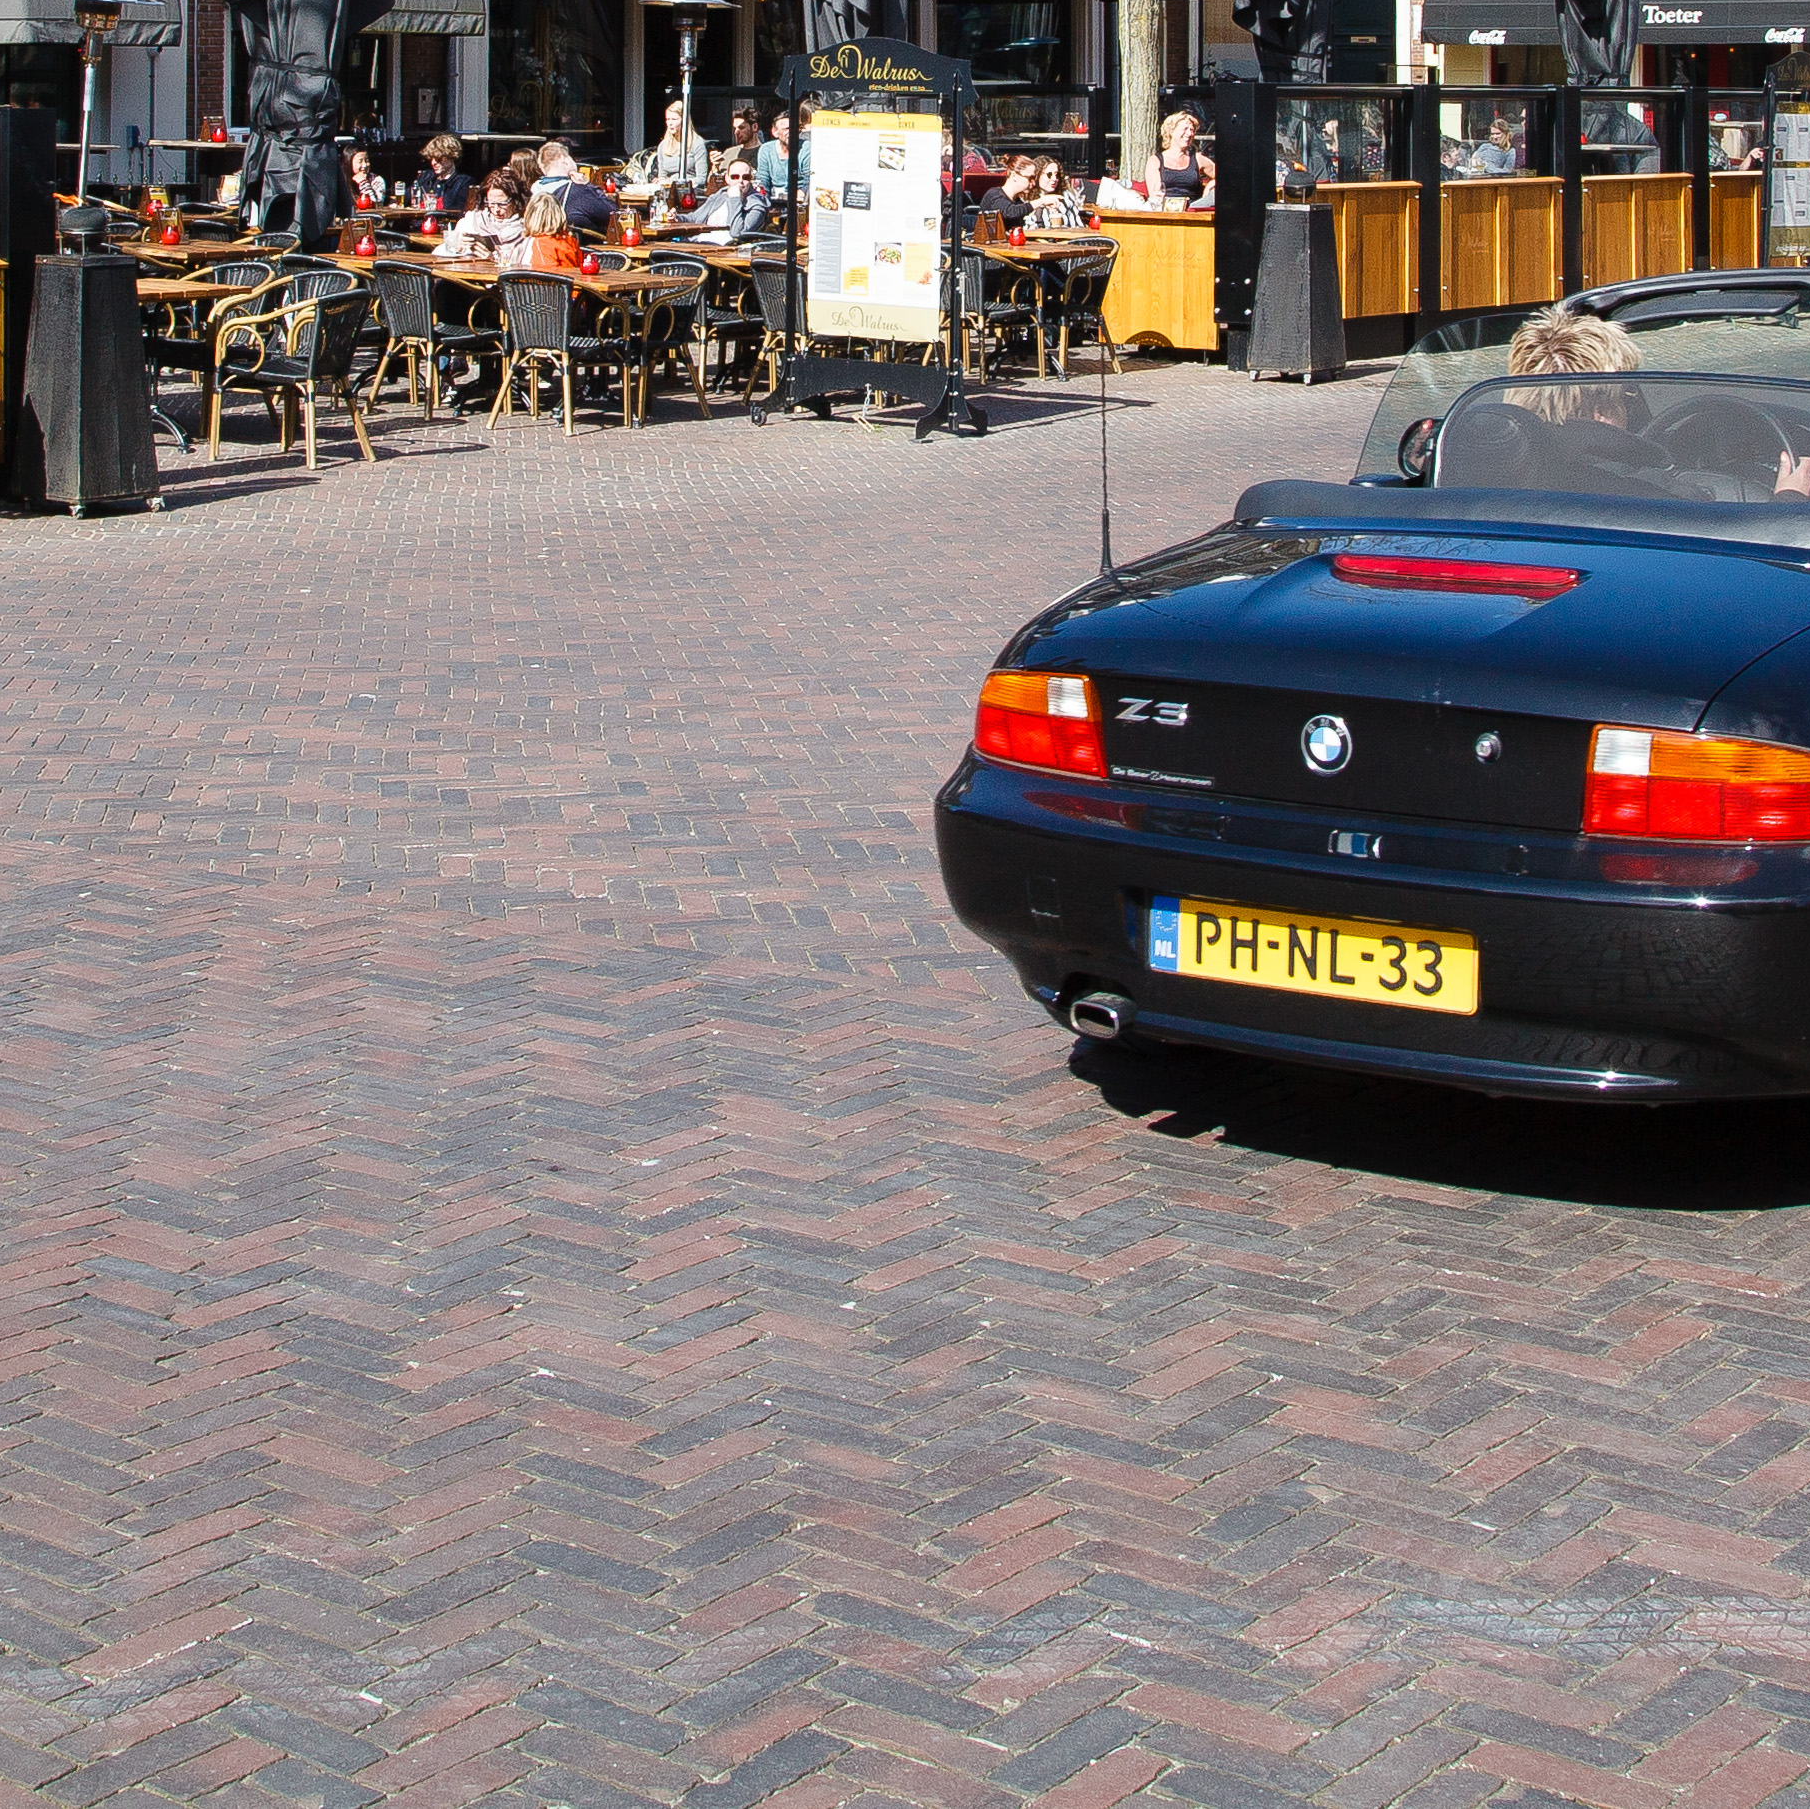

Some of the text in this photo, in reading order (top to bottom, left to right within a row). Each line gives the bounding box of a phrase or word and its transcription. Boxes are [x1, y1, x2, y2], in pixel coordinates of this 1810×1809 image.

[1642, 5, 1703, 24] Toeter
[810, 44, 935, 81] De Walrus
[831, 305, 909, 332] De Walrus
[1115, 697, 1189, 727] Z3
[1154, 939, 1177, 959] NL
[1195, 911, 1444, 997] PH-NL-33
